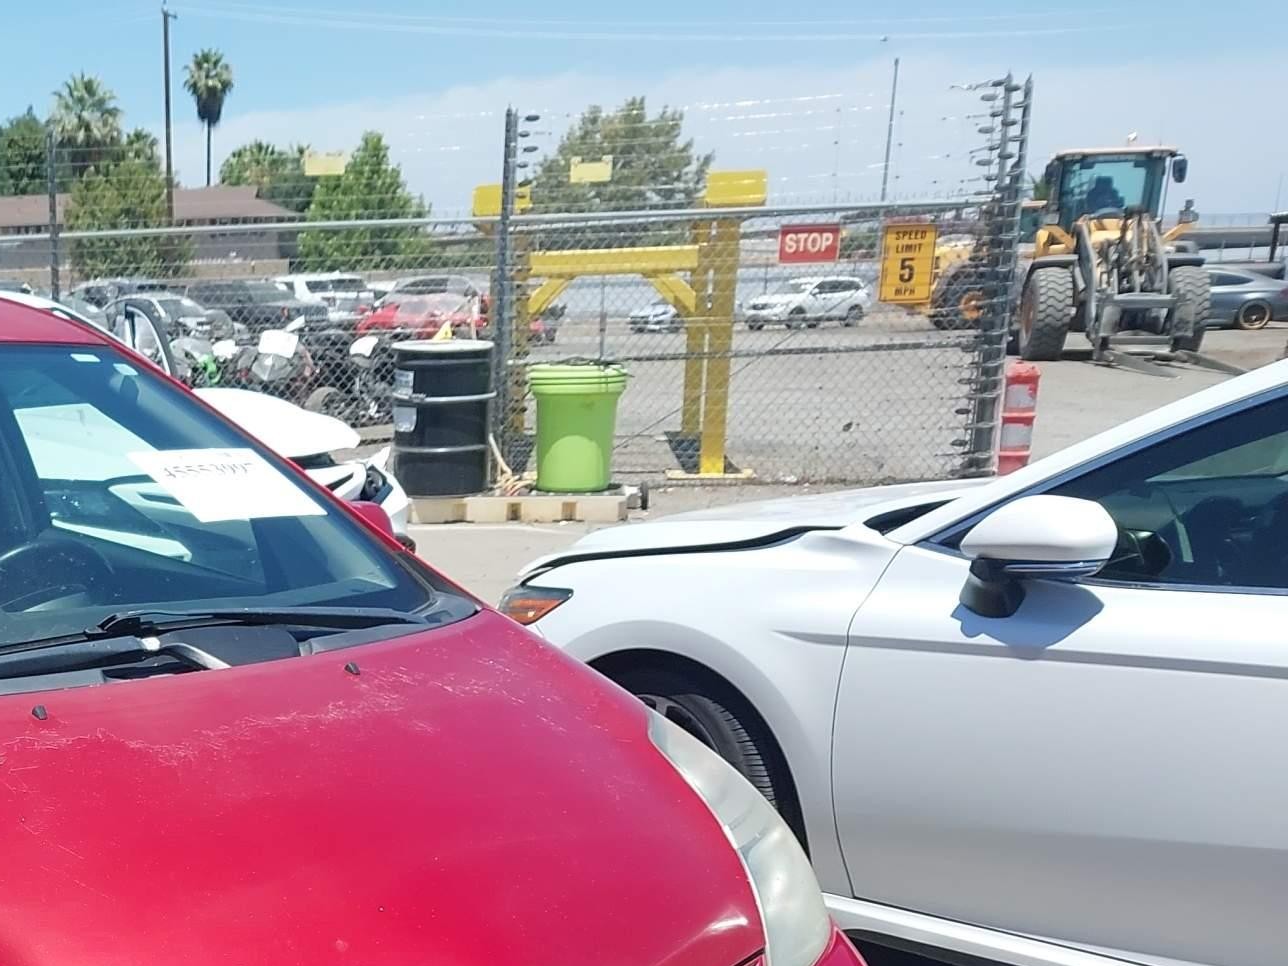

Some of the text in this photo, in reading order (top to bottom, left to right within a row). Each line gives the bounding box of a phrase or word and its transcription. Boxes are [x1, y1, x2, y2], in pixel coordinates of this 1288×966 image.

[895, 230, 927, 240] SPEED
[785, 232, 833, 253] STOP
[895, 243, 923, 253] LIMIT
[899, 257, 915, 283] 5
[894, 287, 916, 297] MPH
